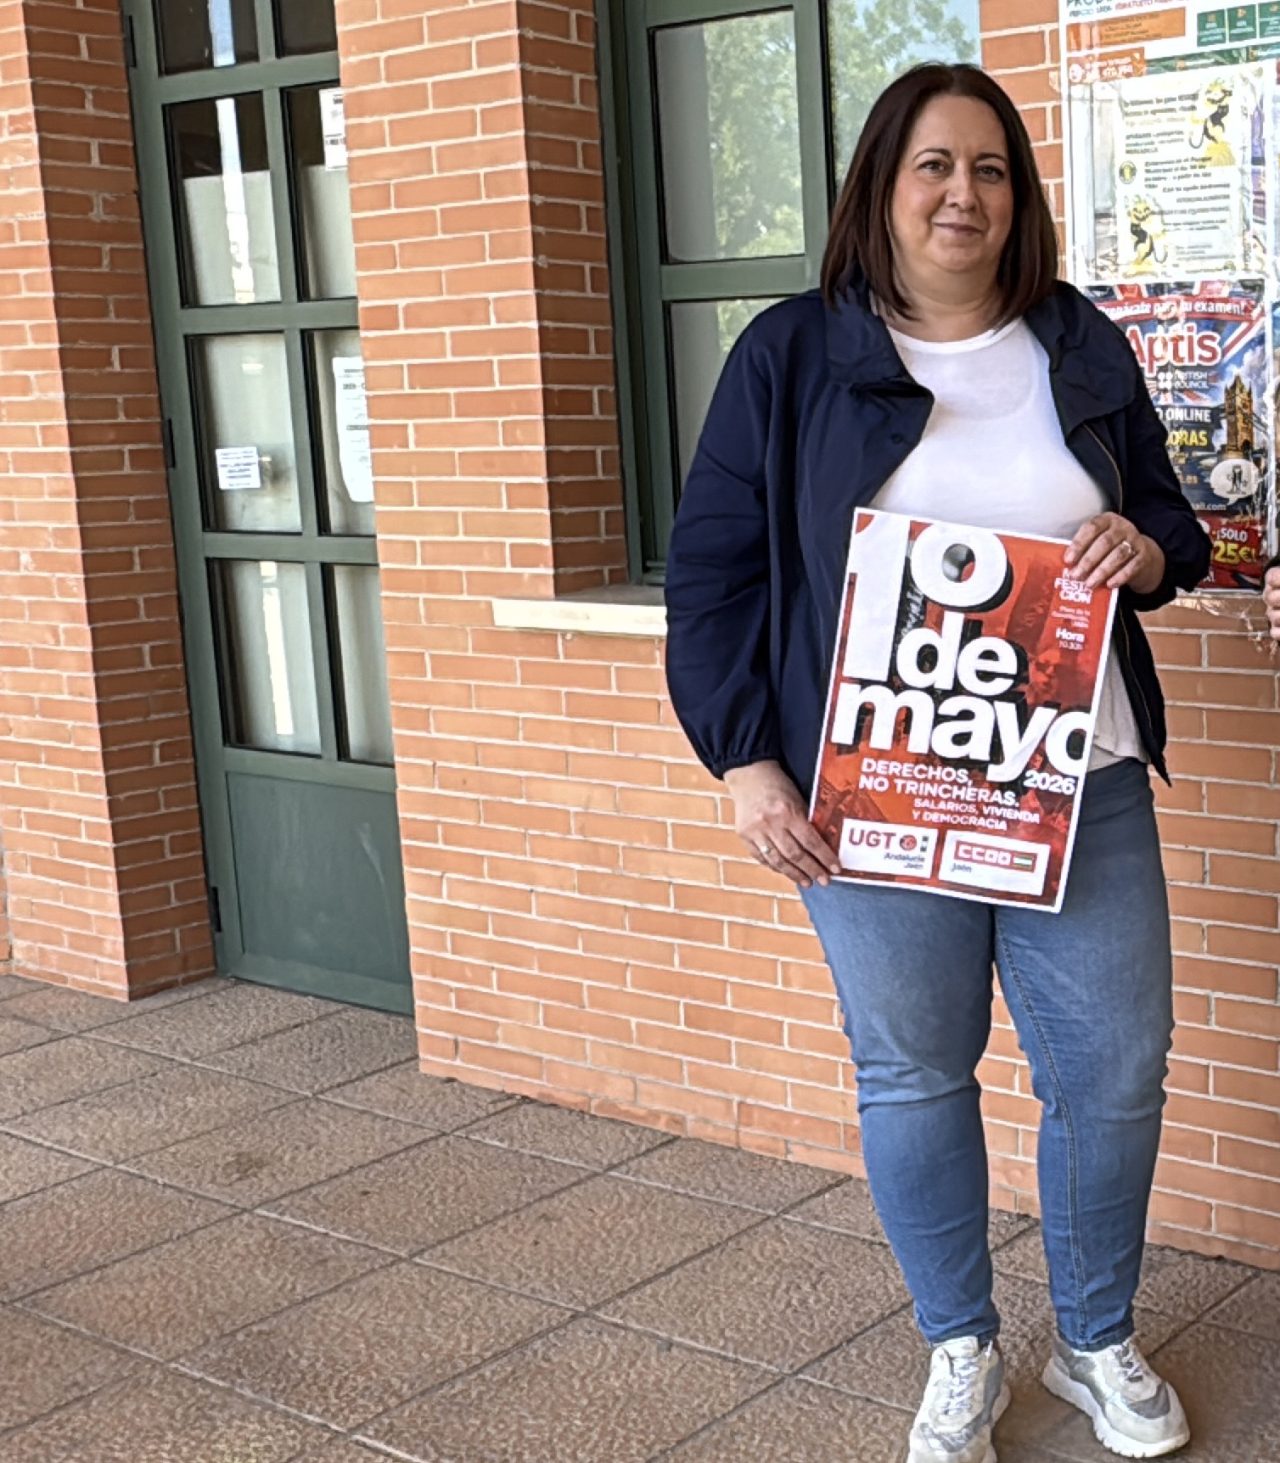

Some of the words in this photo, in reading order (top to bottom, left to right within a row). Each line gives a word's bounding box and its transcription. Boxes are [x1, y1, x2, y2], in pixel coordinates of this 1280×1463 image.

[1194, 300, 1245, 316] examen!
[1127, 325, 1220, 377] Aptis
[1165, 407, 1212, 423] ONLINE
[1166, 430, 1208, 446] ORAS
[1216, 527, 1248, 542] ¡SOLO
[1213, 540, 1257, 566] 25€!
[1055, 626, 1085, 643] Hora
[896, 610, 1018, 697] de
[831, 681, 1092, 783] mayo
[861, 757, 974, 788] DERECHOS,
[1023, 768, 1077, 796] 2026
[858, 774, 890, 792] NO
[894, 778, 1020, 808] TRINCHERAS.
[912, 810, 920, 821] Y
[923, 812, 1008, 832] DEMOCRACIA
[914, 798, 978, 816] SALARIOS,
[981, 805, 1041, 824] VIVIENDA
[848, 826, 896, 850] UGT
[957, 843, 1012, 866] CCOO
